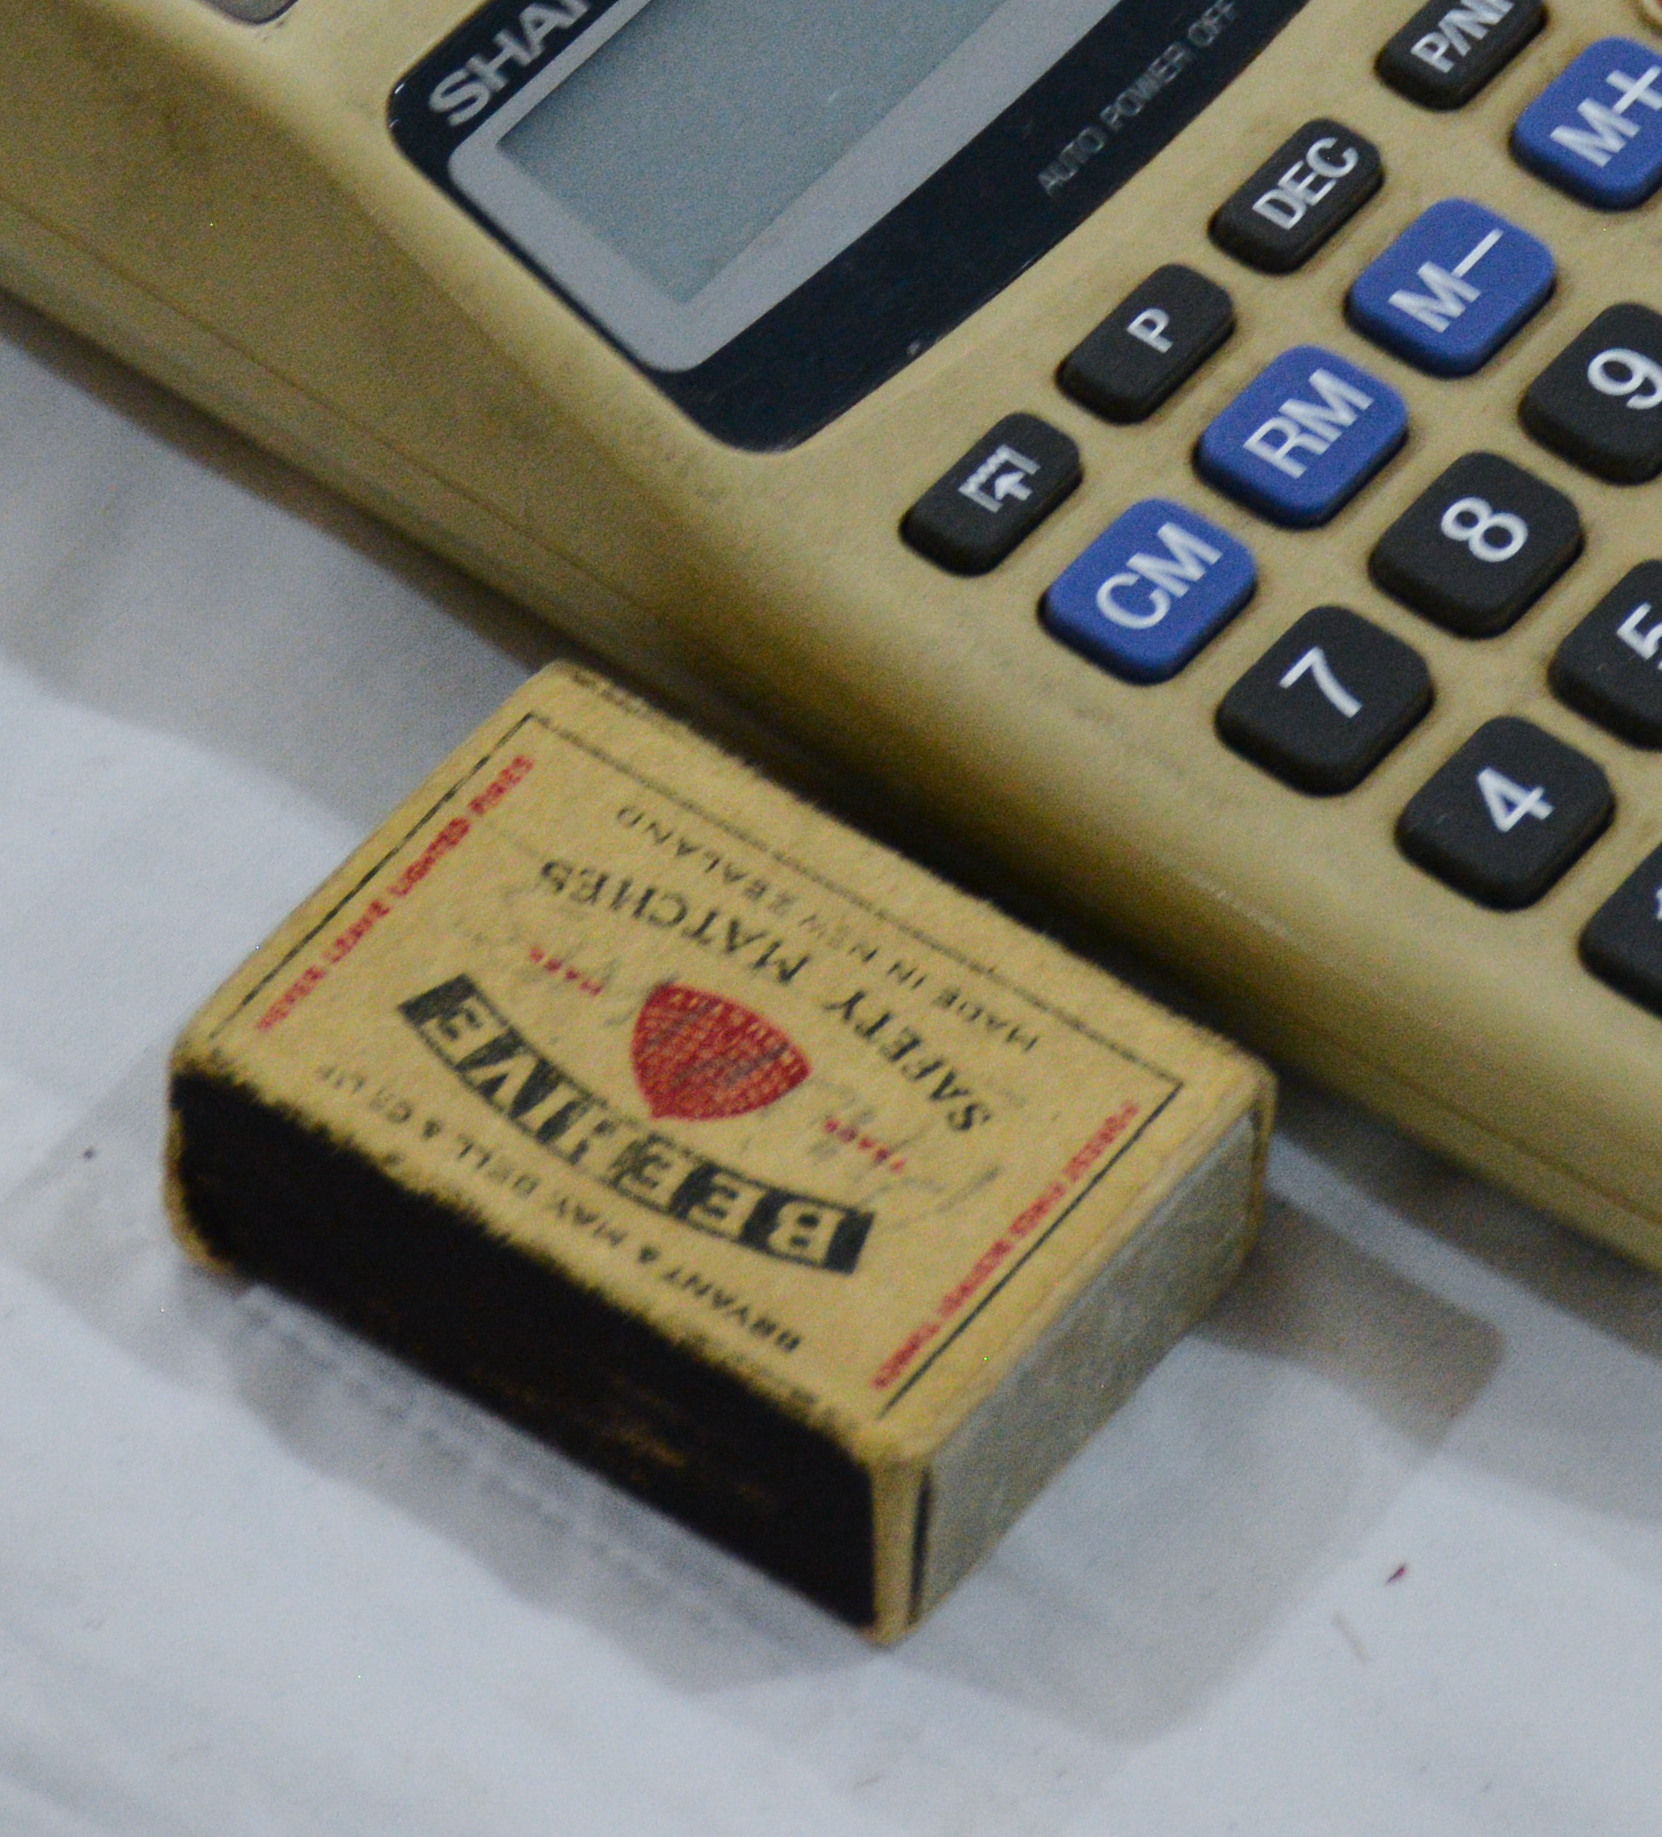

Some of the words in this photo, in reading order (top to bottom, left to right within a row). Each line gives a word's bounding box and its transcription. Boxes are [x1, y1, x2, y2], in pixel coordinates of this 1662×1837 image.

[1038, 126, 1108, 198] AUTO
[1099, 41, 1195, 132] POWER
[1253, 137, 1359, 230] DEC
[1126, 308, 1172, 354] P
[1243, 368, 1374, 479] RM
[1095, 519, 1224, 630] CM
[1440, 497, 1528, 563] 8
[1279, 647, 1361, 718] 7
[1476, 768, 1553, 832] 4
[615, 804, 796, 914] ZEALAND
[541, 859, 813, 986] MATCHES
[887, 960, 929, 990] IN
[931, 986, 1039, 1053] MADE
[821, 989, 992, 1133] SAFETY
[413, 986, 851, 1274] BEEHIVE
